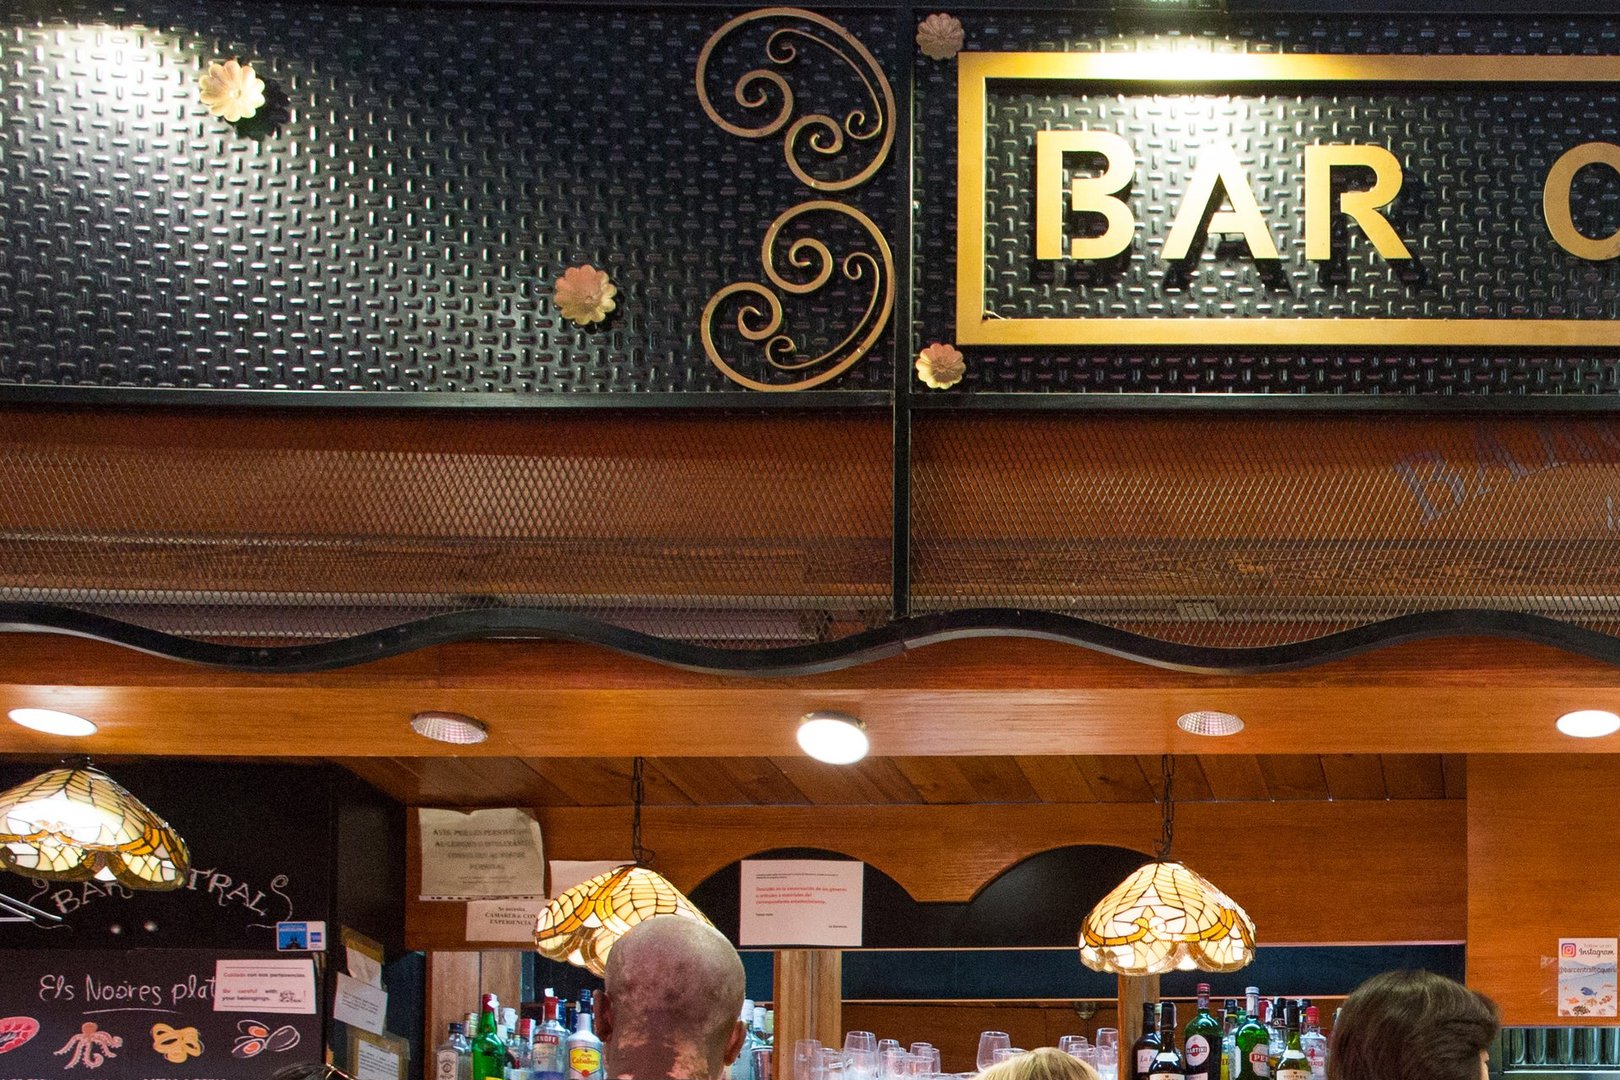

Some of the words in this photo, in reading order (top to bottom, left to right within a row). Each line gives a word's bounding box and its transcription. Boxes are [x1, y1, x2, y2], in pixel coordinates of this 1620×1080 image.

[1035, 129, 1413, 262] BAR
[1579, 948, 1615, 958] Instagram
[39, 974, 75, 1000] Els
